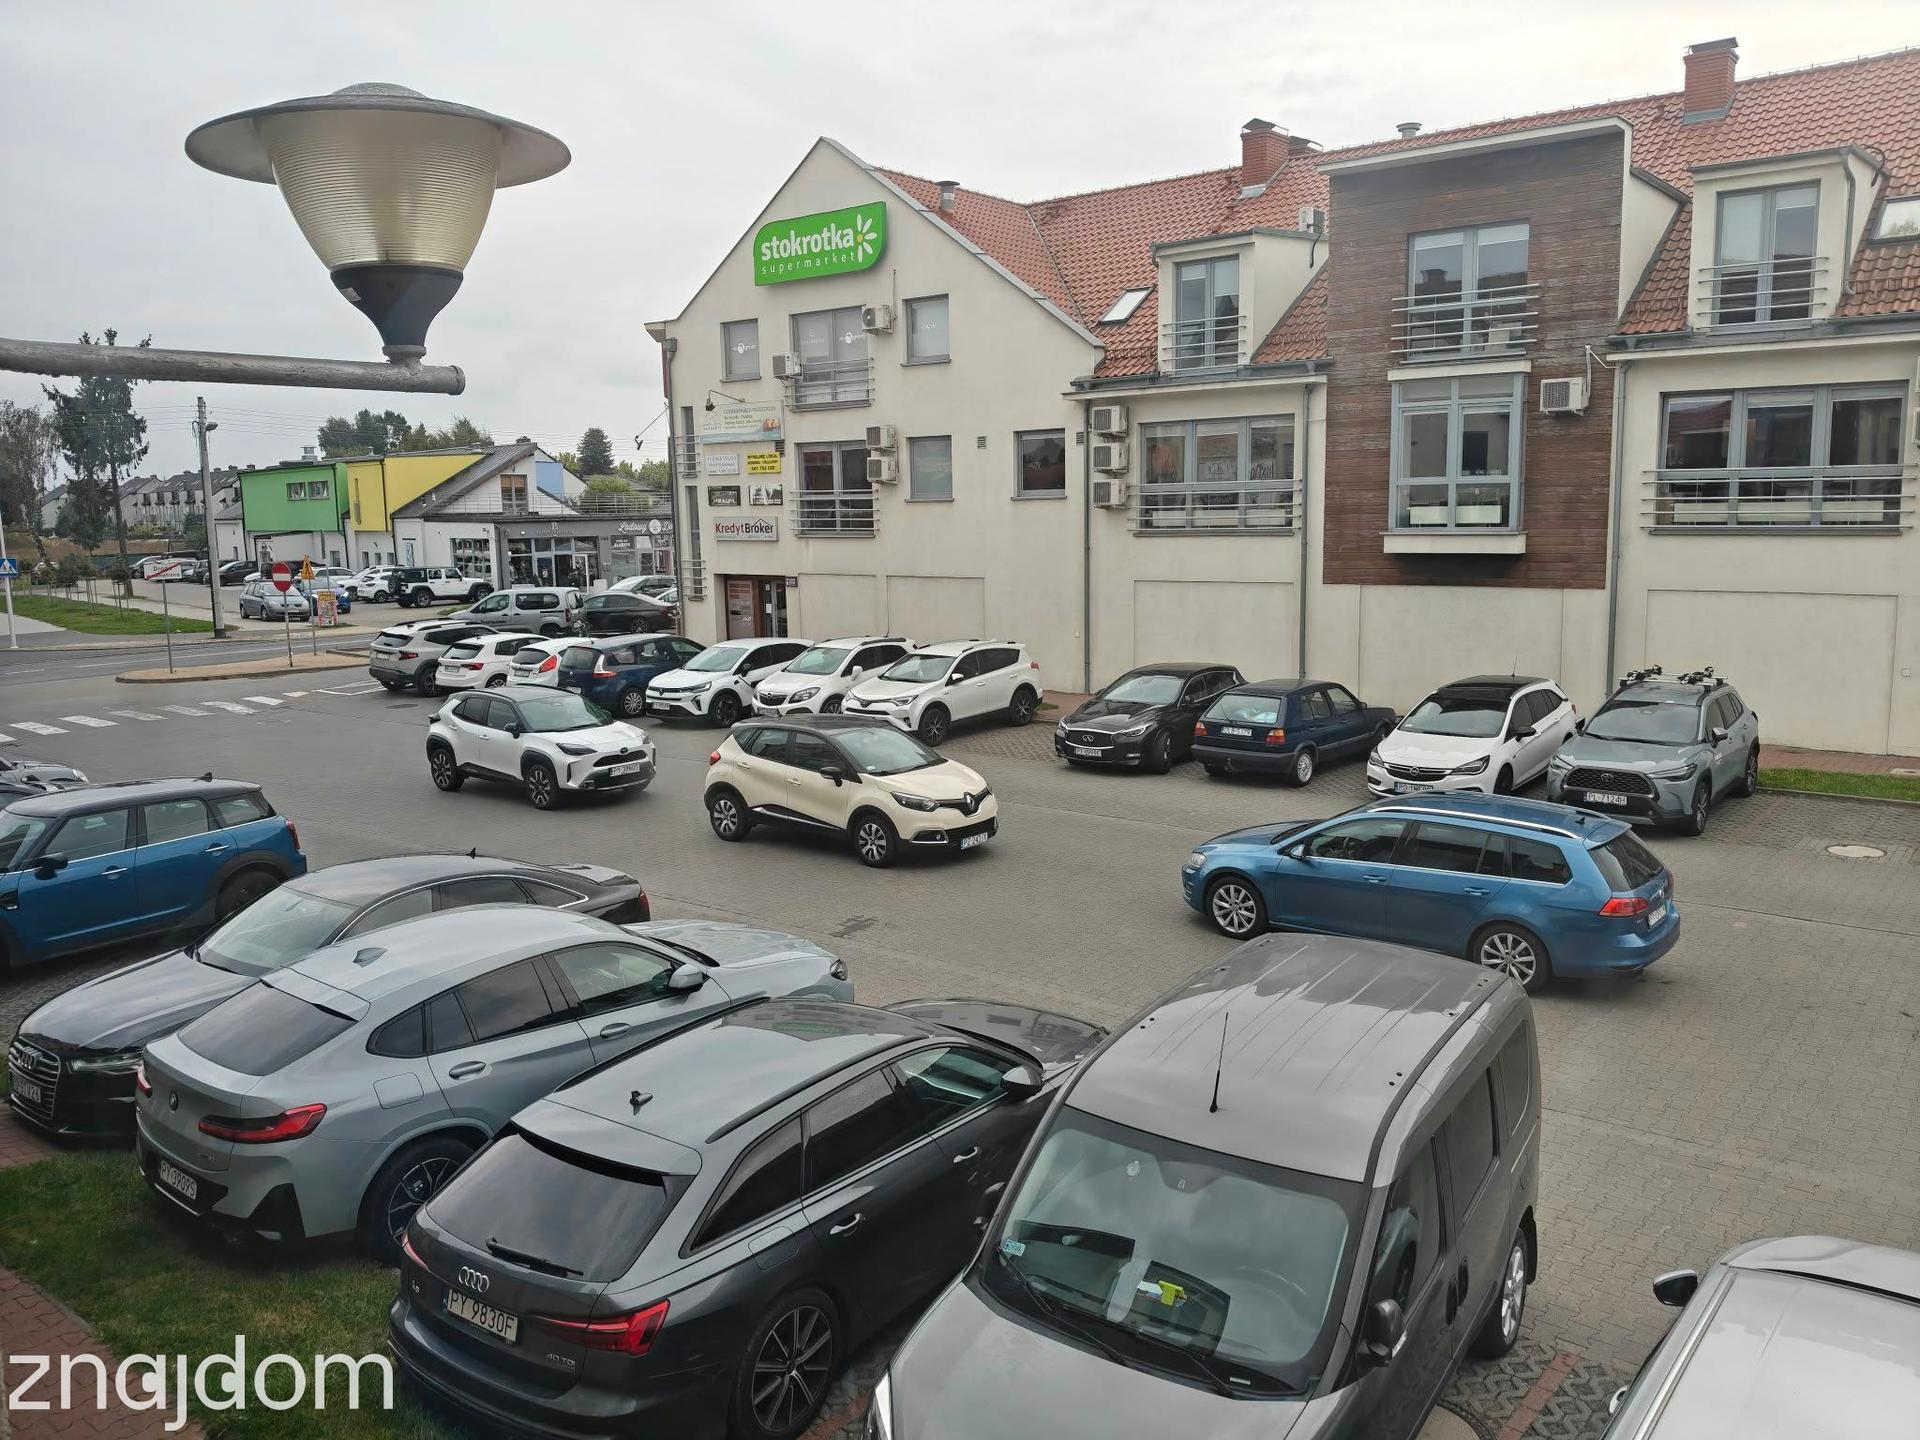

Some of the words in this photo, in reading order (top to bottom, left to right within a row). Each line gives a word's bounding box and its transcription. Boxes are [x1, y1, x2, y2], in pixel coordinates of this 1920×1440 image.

[761, 223, 854, 261] stokrotka
[762, 251, 854, 274] supermarket
[618, 521, 648, 534] Lodowy
[715, 522, 773, 535] KredytBroker
[172, 1170, 195, 1197] 3909S
[450, 1292, 469, 1315] PY
[471, 1303, 514, 1336] 9830F
